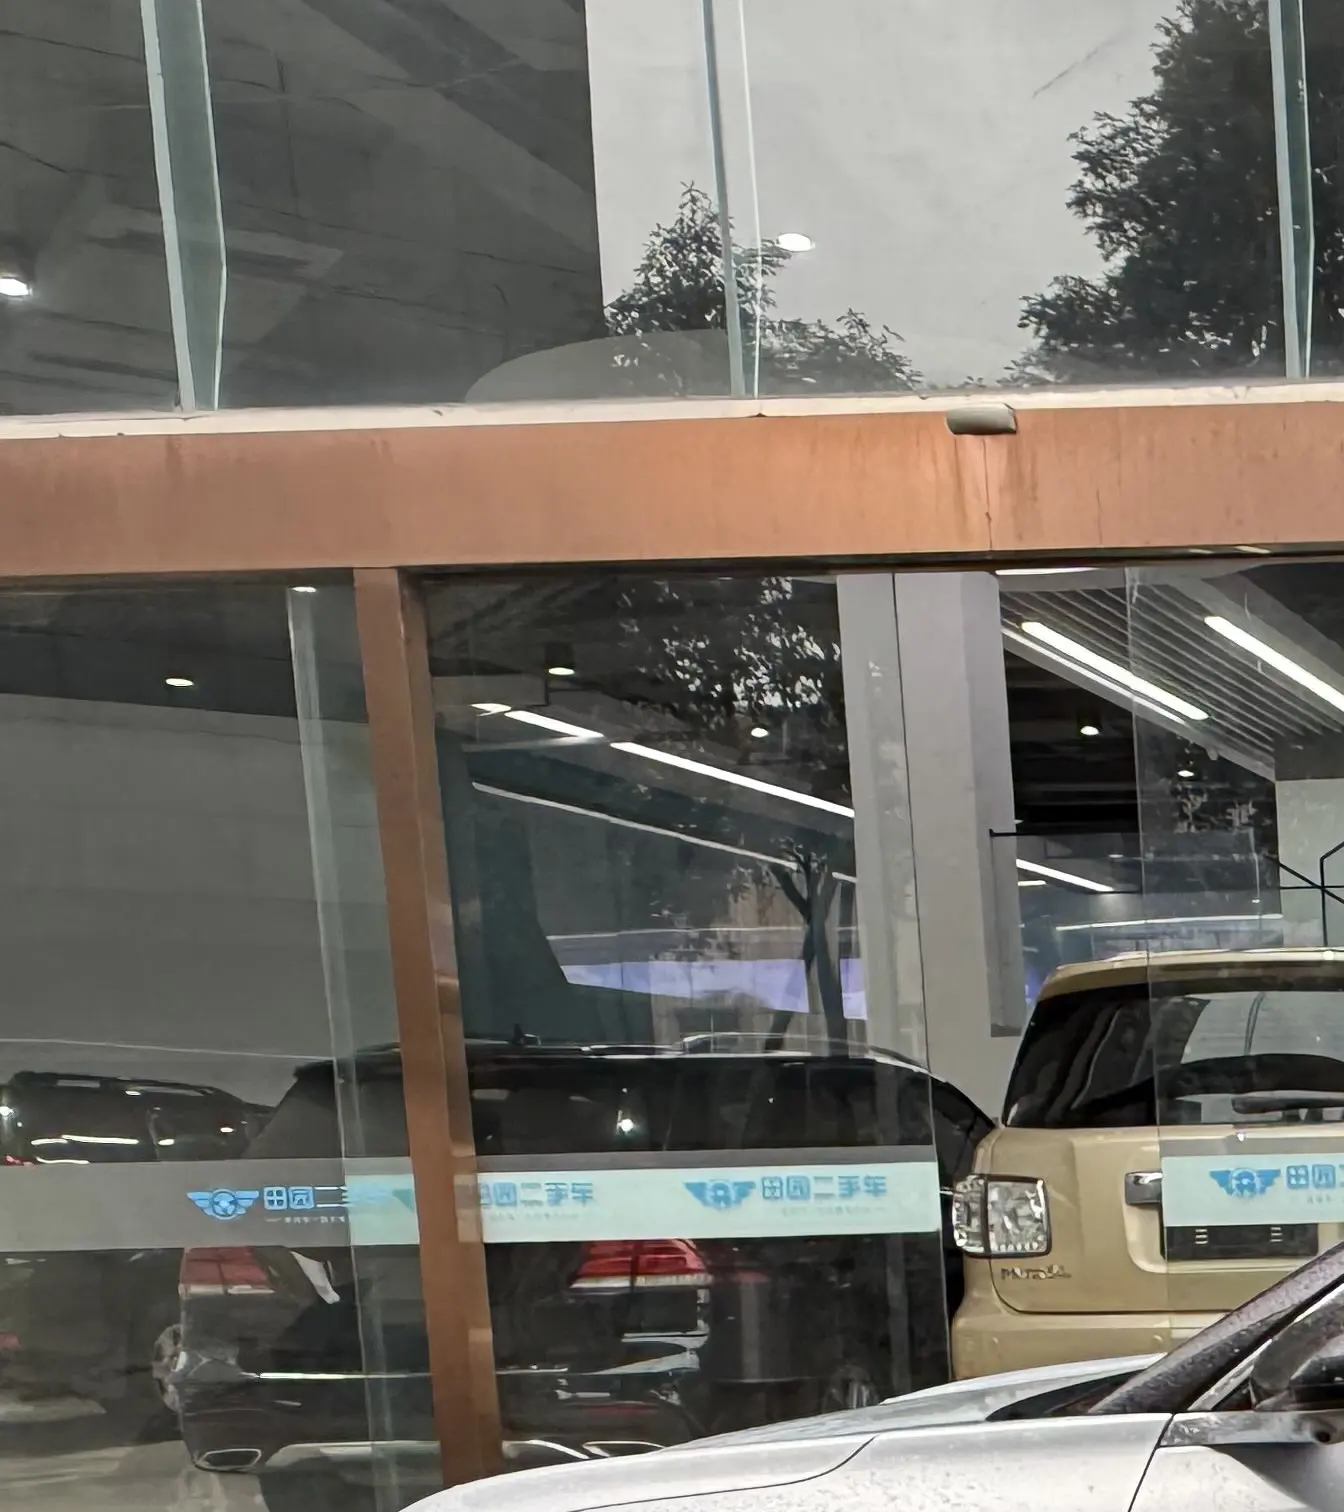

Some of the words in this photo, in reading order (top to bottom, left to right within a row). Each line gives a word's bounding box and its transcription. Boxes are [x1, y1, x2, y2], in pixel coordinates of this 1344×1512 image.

[263, 1185, 376, 1211] 田园二
[760, 1174, 888, 1201] 田园二手车
